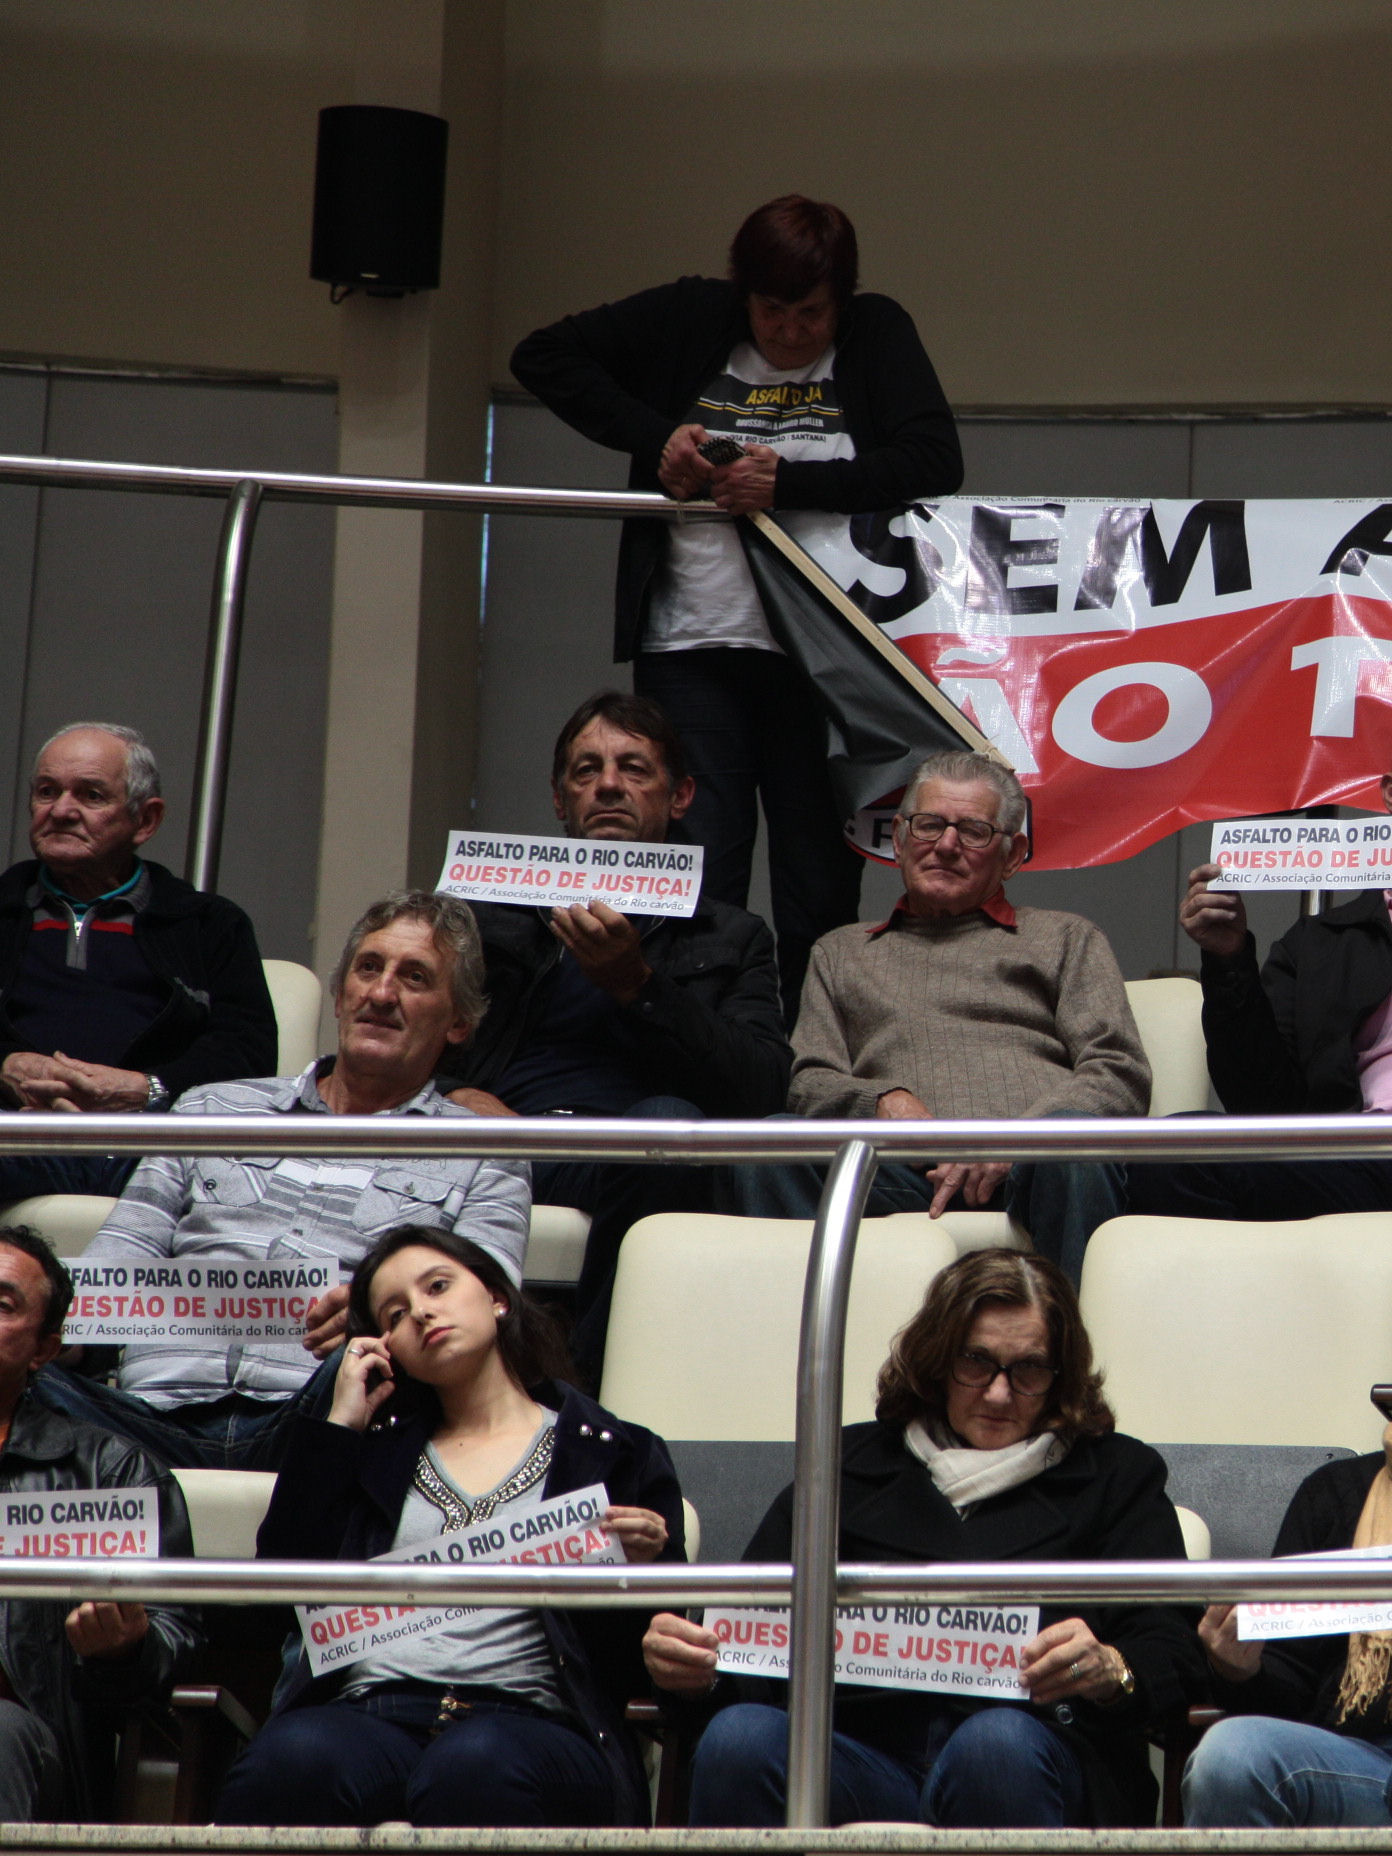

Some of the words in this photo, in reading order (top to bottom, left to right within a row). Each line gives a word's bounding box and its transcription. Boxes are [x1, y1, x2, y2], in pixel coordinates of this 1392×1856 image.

[745, 386, 802, 405] ASFALO
[847, 500, 1252, 624] SEM
[934, 647, 1213, 774] ÃO
[1220, 827, 1292, 845] ASFALTO
[1297, 827, 1340, 843] PARA
[1346, 827, 1358, 843] O
[1363, 825, 1391, 842] RIO
[455, 840, 524, 860] ASFALTO
[529, 845, 570, 863] PARA
[575, 848, 587, 864] O
[591, 849, 619, 866] RIO
[623, 849, 693, 871] CARVÃO!
[1216, 845, 1323, 869] QUESTÃO
[1331, 850, 1360, 868] DE
[449, 863, 551, 887] QUESTÃO
[557, 871, 587, 889] DE
[591, 874, 692, 900] JUSTIÇA!
[1216, 874, 1252, 883] ACRIC
[1262, 873, 1323, 884] Associação
[1325, 871, 1391, 883] Comunitária
[444, 885, 480, 895] ACRIC
[488, 888, 546, 900] Associação
[614, 896, 627, 906] do
[630, 898, 647, 908] Rio
[649, 900, 684, 911] carvão
[71, 1267, 128, 1287] FALTO
[133, 1268, 182, 1287] PARA
[187, 1269, 201, 1288] O
[207, 1270, 238, 1289] RIO
[243, 1263, 328, 1289] CARVÃO!
[65, 1290, 165, 1318] UESTÃO
[174, 1296, 206, 1318] DE
[62, 1324, 84, 1335] RIC
[95, 1324, 165, 1338] Associação
[169, 1324, 242, 1337] Comunitária
[246, 1325, 262, 1336] do
[265, 1325, 285, 1336] Rio
[7, 1503, 44, 1525] RIO
[50, 1495, 144, 1524] CARVÃO!
[447, 1542, 463, 1563] O
[468, 1529, 505, 1557] RIO
[509, 1497, 600, 1543] CARVÃO!
[14, 1530, 146, 1557] JUSTIÇA!
[894, 1607, 930, 1627] RIO
[1250, 1620, 1294, 1633] ACRIC
[320, 1641, 358, 1664] ACRIC
[370, 1615, 441, 1647] Associação
[852, 1631, 889, 1657] DE
[846, 1662, 926, 1681] Comunitária
[930, 1670, 948, 1683] do
[951, 1671, 973, 1685] Rio
[977, 1675, 1021, 1689] carvão
